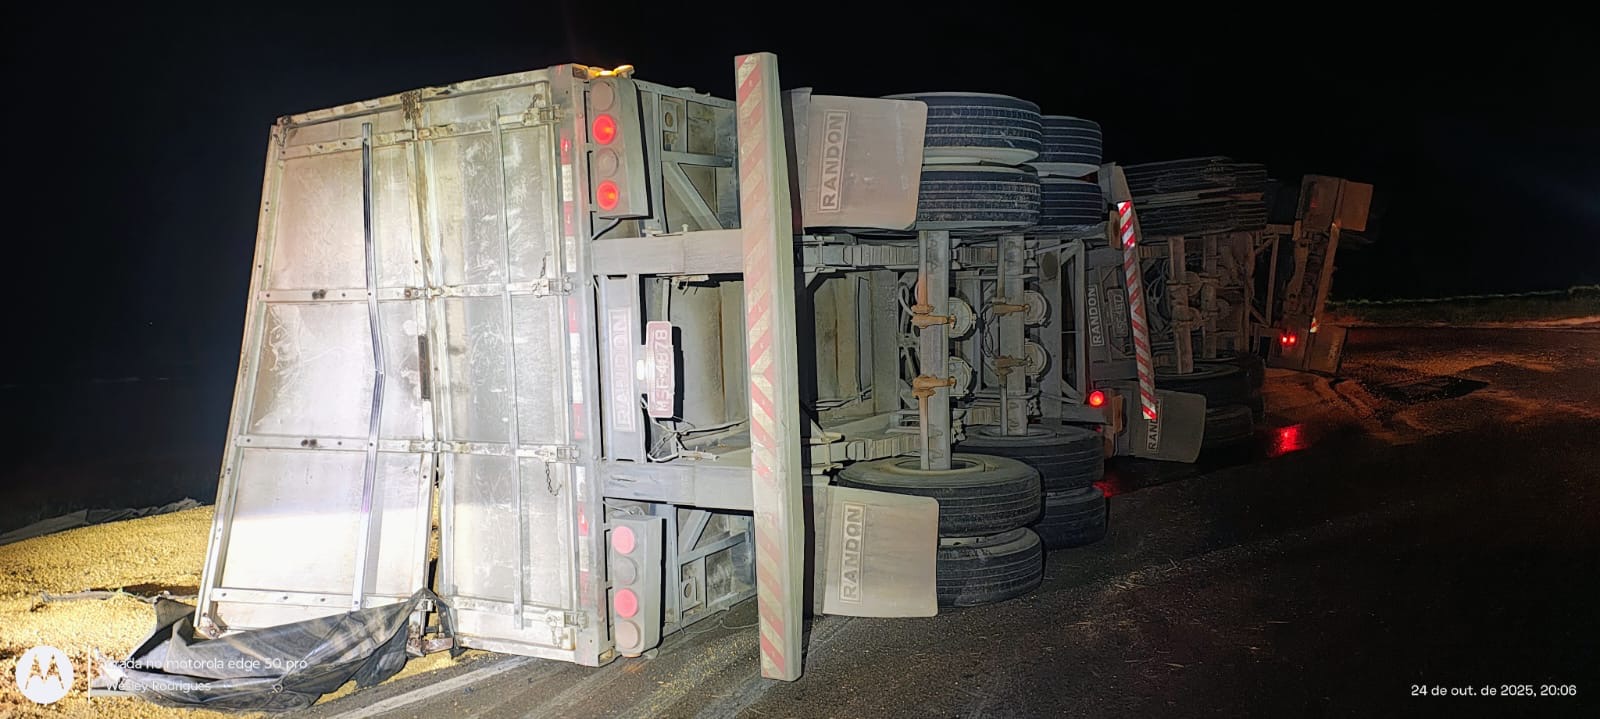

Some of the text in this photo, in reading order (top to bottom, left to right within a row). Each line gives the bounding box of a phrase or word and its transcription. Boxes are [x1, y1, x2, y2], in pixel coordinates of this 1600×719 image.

[822, 115, 844, 207] RANDON
[1087, 287, 1102, 344] RANDON
[611, 314, 631, 425] RANDON
[842, 508, 862, 599] RANDON
